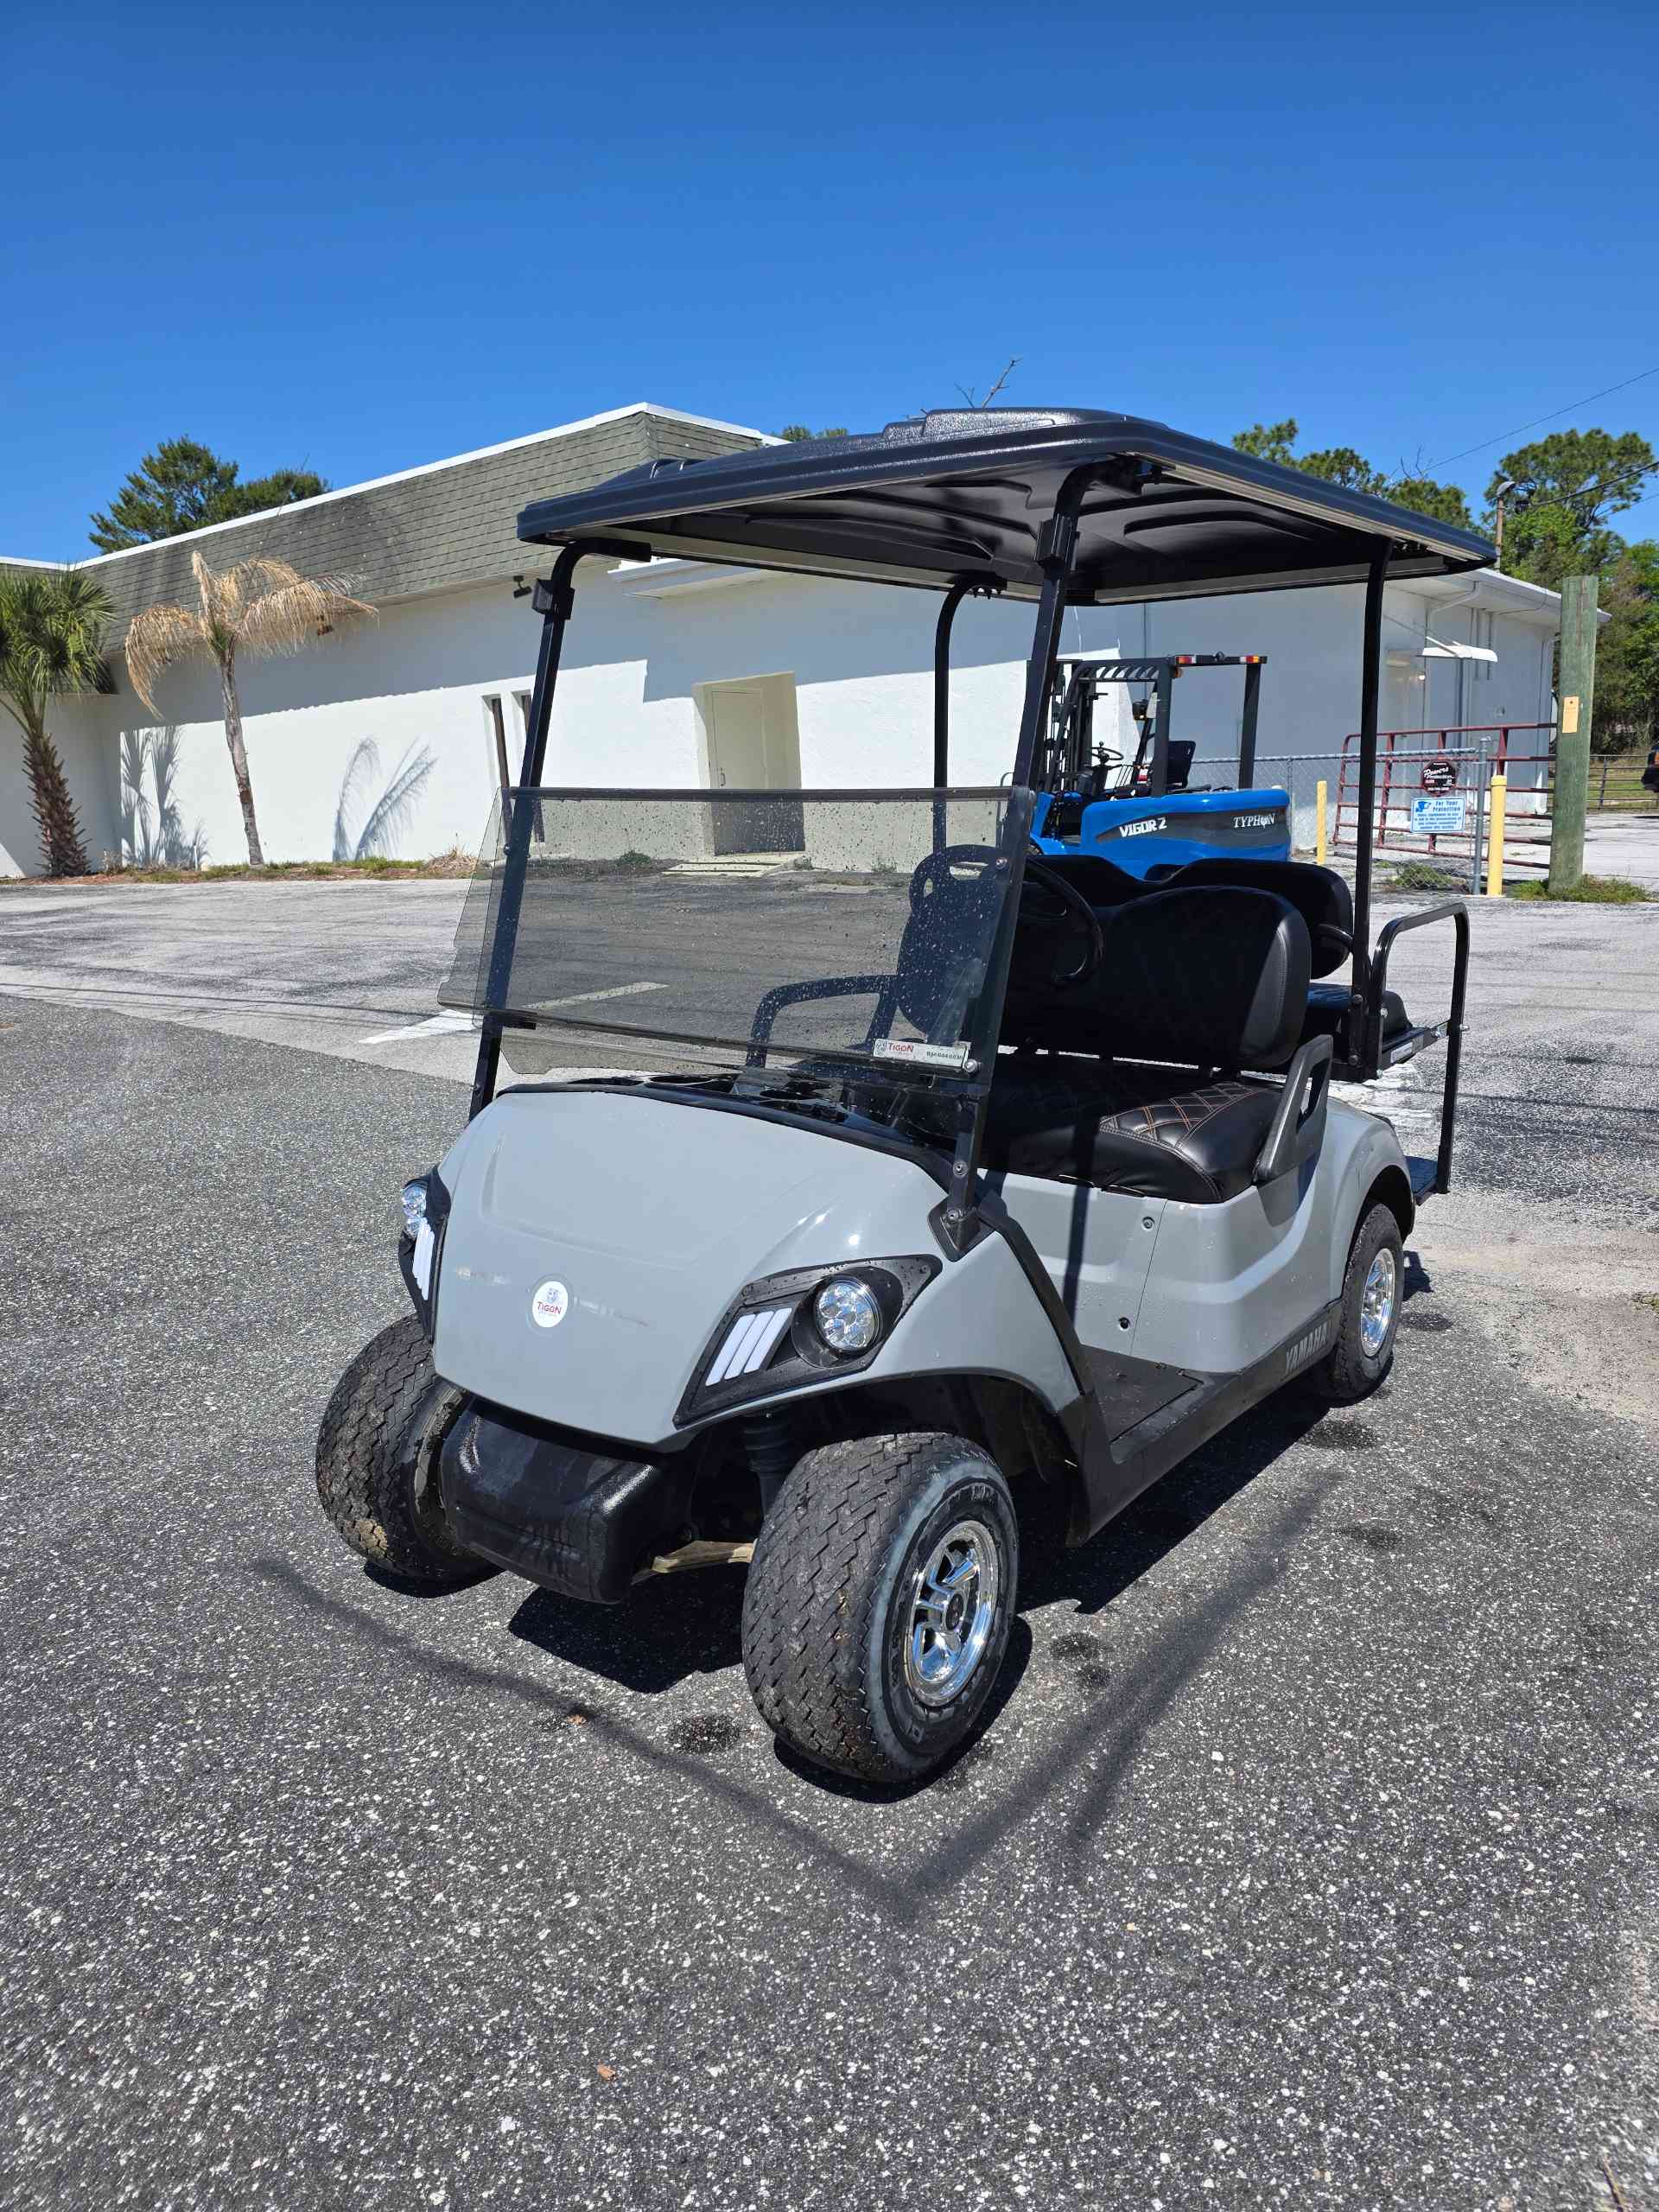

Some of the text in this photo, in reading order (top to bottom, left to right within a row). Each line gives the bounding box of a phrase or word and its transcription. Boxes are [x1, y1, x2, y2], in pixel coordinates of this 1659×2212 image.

[1119, 817, 1167, 837] VIGOR 2
[1233, 813, 1275, 829] TYPHON
[1285, 1321, 1328, 1376] YAMAHA
